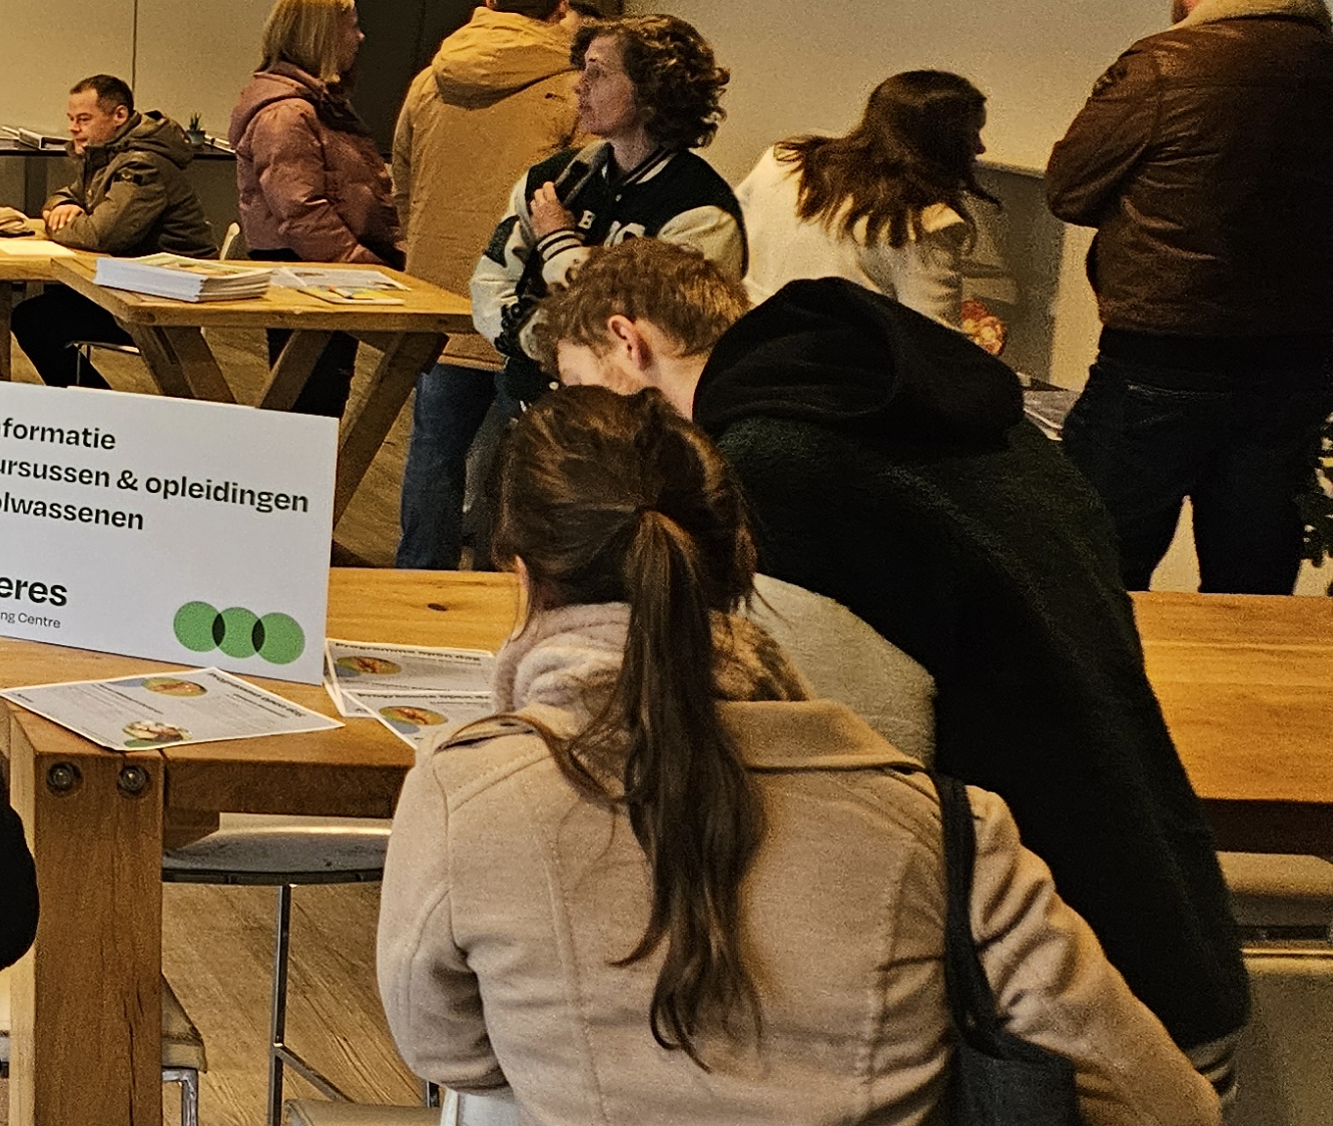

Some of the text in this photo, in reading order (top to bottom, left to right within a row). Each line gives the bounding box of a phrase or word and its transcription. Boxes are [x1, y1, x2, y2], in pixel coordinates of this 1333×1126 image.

[117, 470, 139, 491] &
[145, 476, 309, 513] opleidingen
[18, 612, 61, 628] Centre
